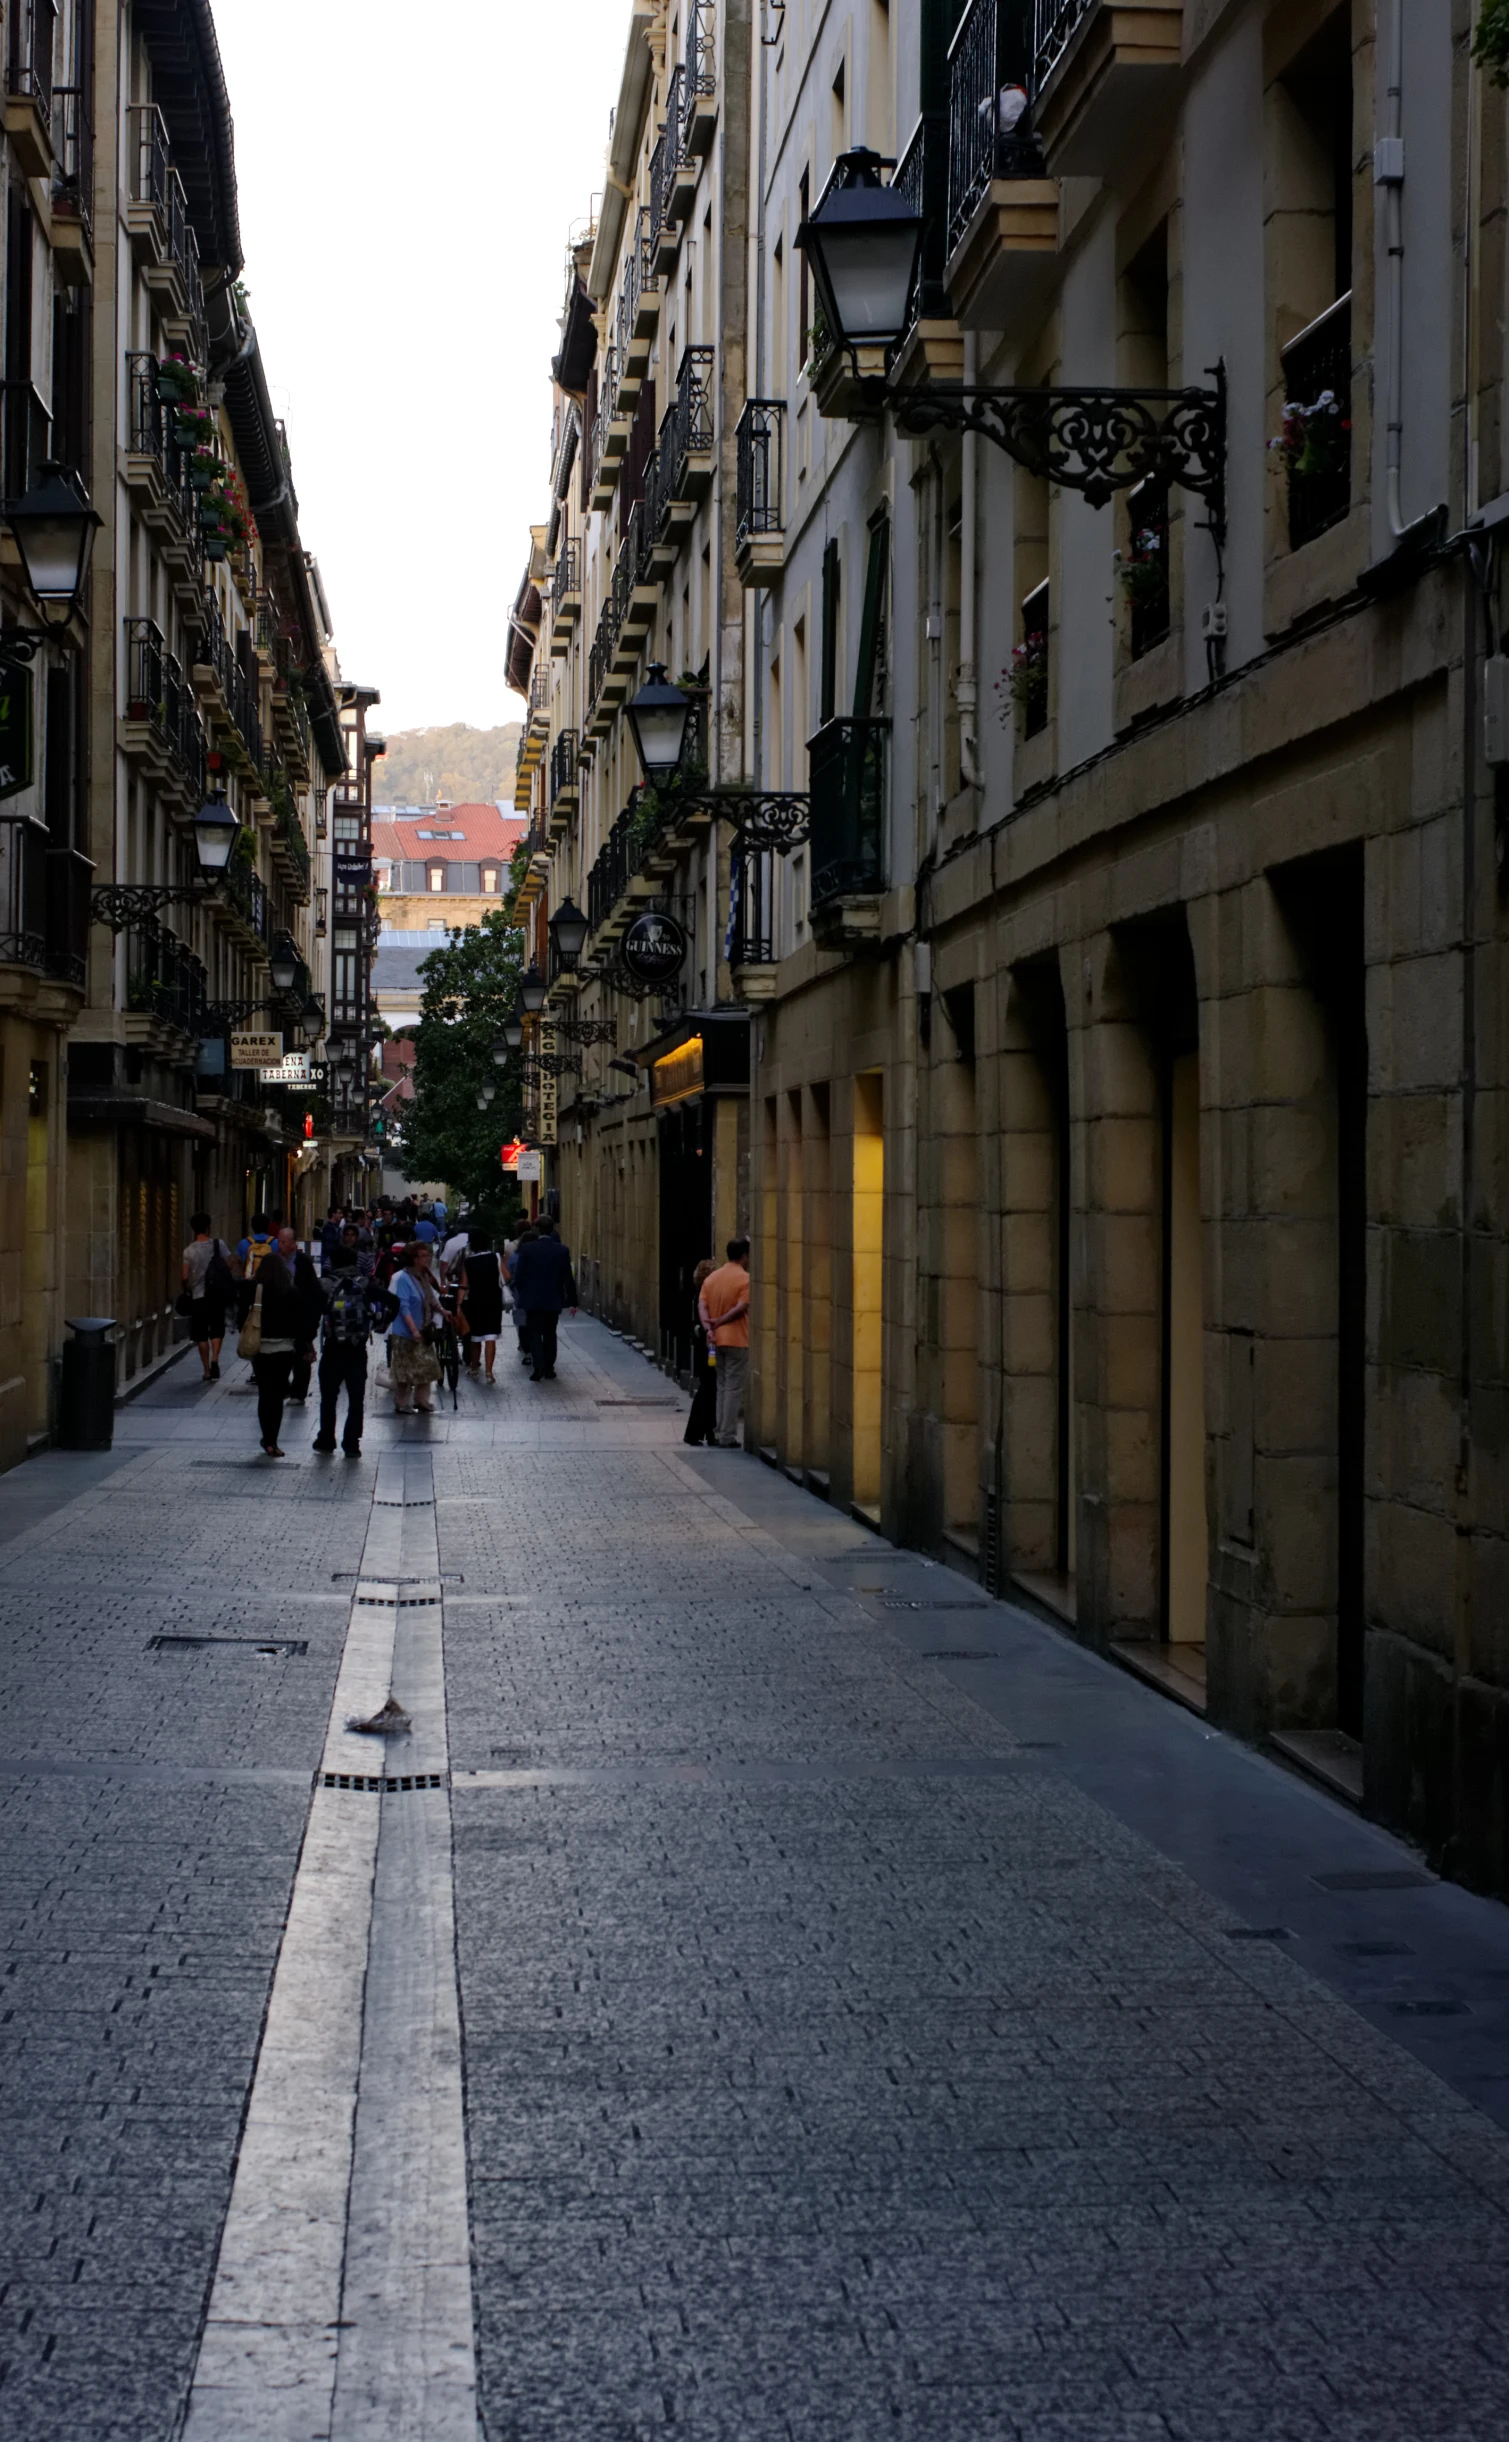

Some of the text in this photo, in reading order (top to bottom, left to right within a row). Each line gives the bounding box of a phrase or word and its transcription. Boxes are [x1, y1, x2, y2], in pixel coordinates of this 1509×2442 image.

[626, 940, 683, 955] GUINNESS
[231, 1037, 276, 1046] GAREX
[238, 1049, 269, 1057] TALLER DE
[283, 1057, 304, 1066] ENA
[262, 1070, 307, 1080] TABERNA
[310, 1068, 324, 1080] XO
[541, 1023, 556, 1142] AGDOTEGIA
